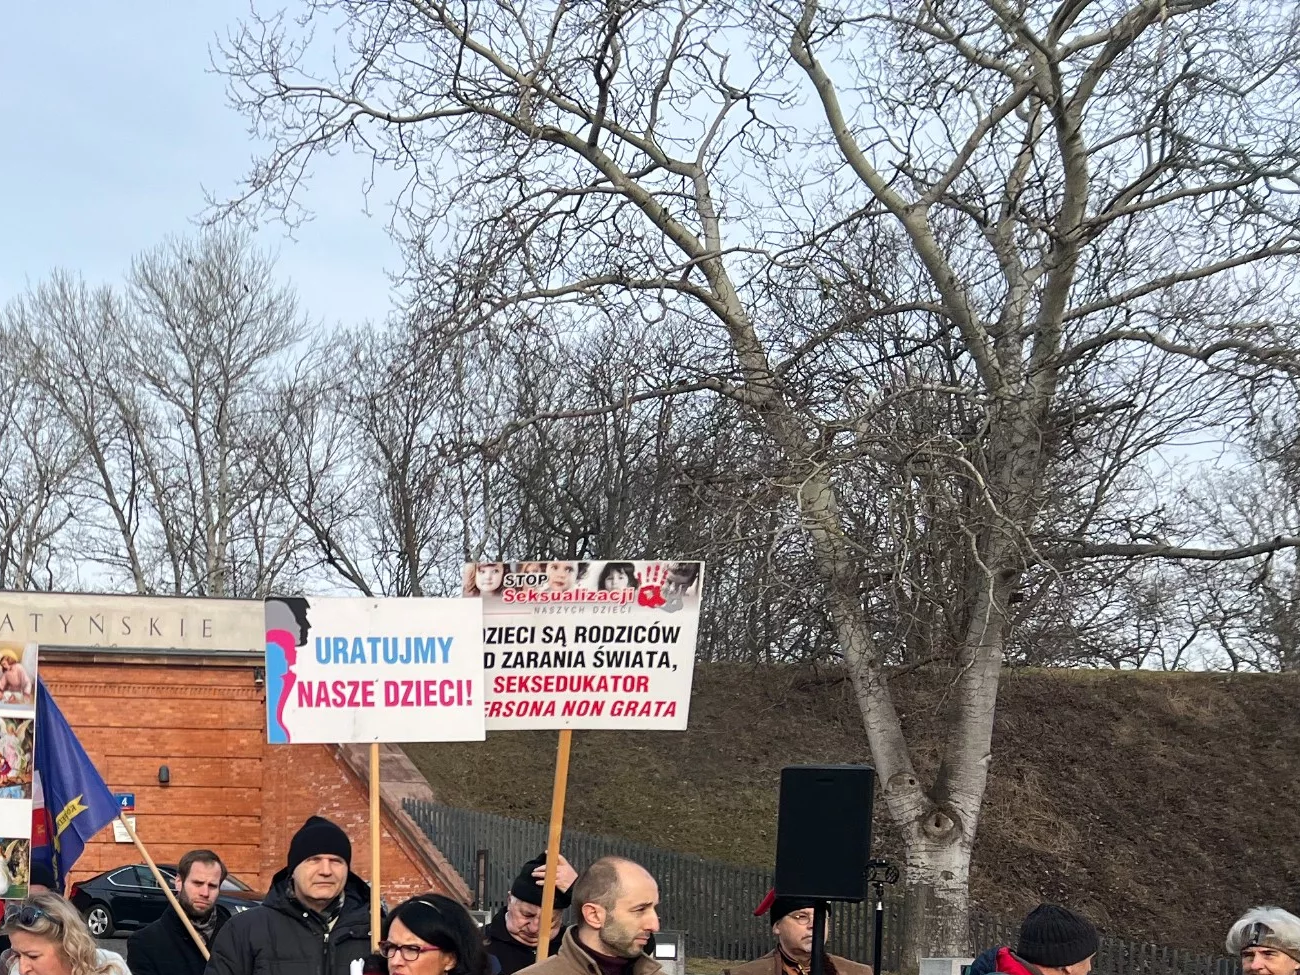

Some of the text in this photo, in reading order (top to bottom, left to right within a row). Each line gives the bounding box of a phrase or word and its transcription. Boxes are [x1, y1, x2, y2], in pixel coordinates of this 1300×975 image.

[504, 573, 548, 587] STOP
[503, 588, 634, 605] Seksualizacji
[534, 605, 633, 615] NASZYCH DZIECI
[541, 625, 567, 647] SĄ
[574, 621, 681, 645] RODZICÓW
[315, 636, 453, 665] URATUJMY
[501, 650, 586, 669] ZARANIA
[592, 645, 677, 672] ŚWIATA,
[297, 679, 473, 709] NASZE DZIECI!
[494, 675, 649, 694] SEKSEDUKATOR
[562, 699, 605, 717] NON
[610, 700, 677, 717] GRATA
